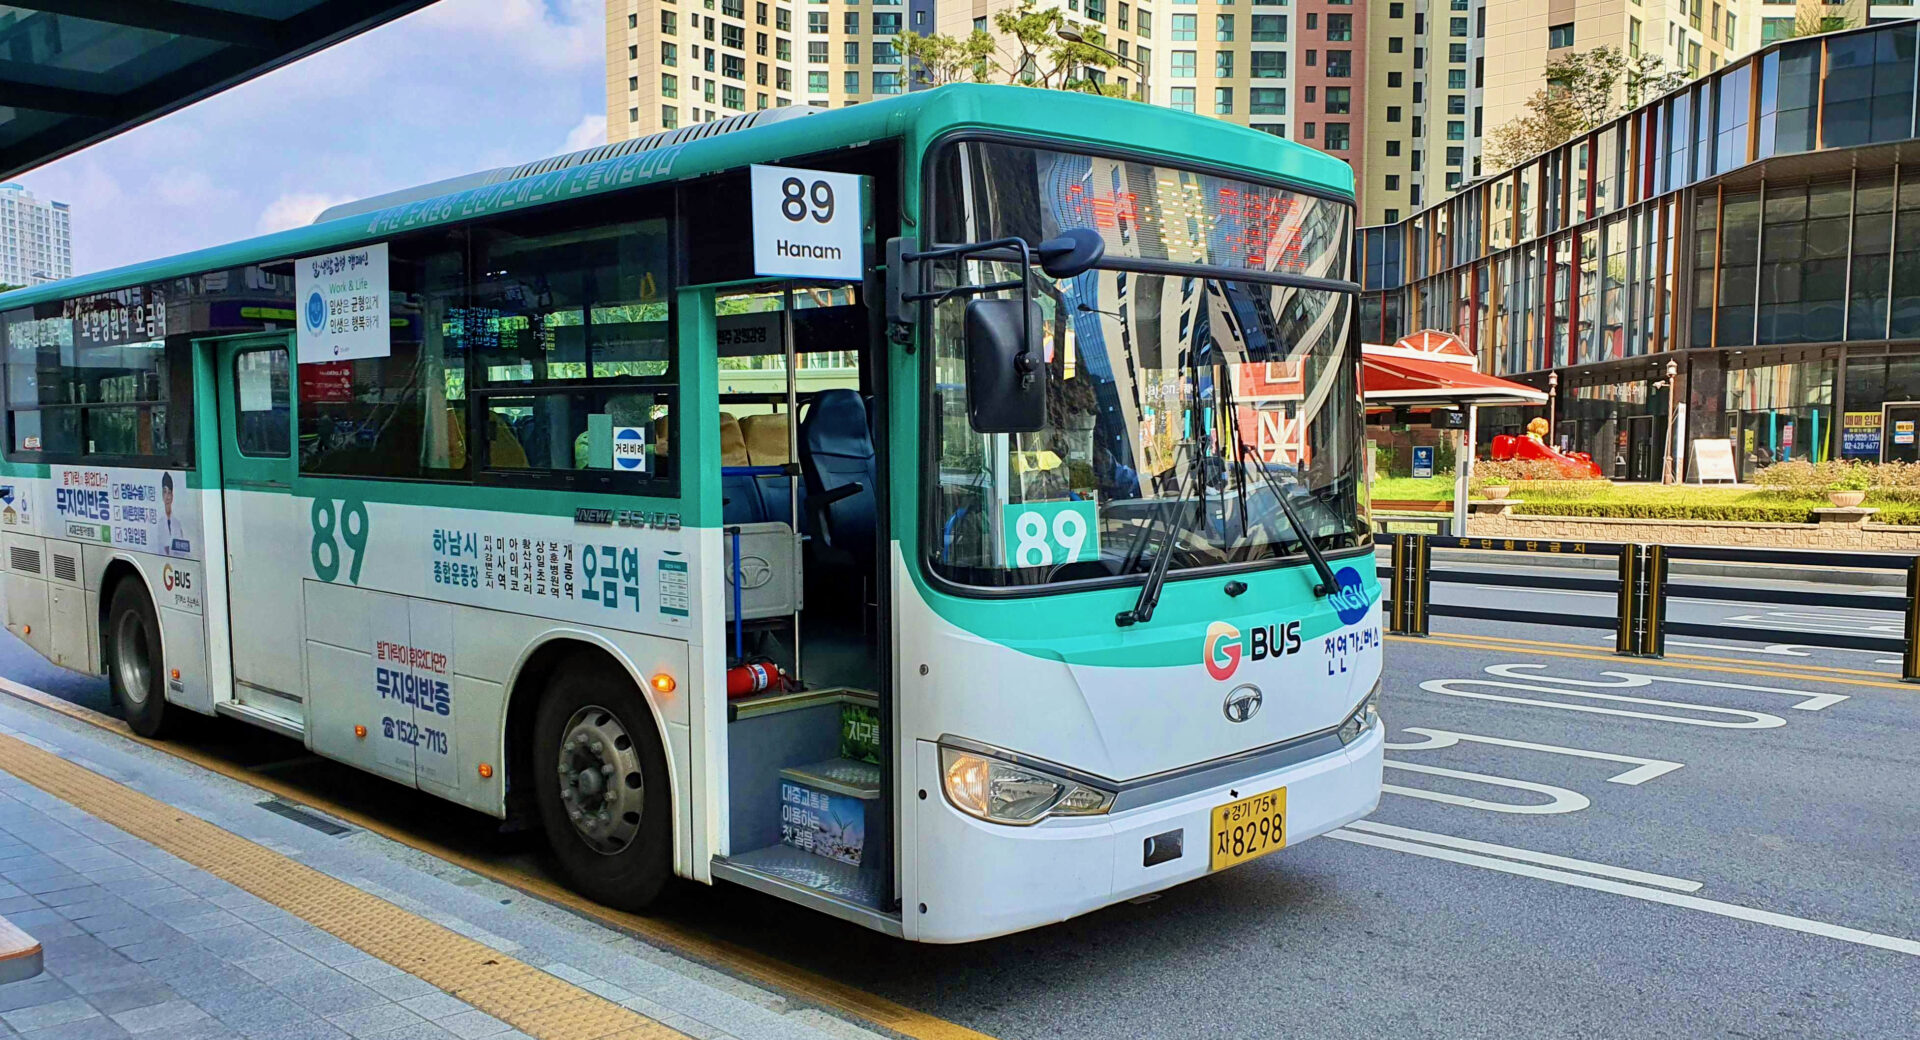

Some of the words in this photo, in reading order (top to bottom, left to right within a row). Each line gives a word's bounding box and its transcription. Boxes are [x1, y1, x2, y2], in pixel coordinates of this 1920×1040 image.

[781, 176, 835, 224] 89
[776, 239, 842, 260] Hanam
[329, 281, 346, 294] Work
[348, 281, 354, 291] &
[355, 280, 368, 290] Life
[330, 298, 350, 315] 일상은
[351, 295, 379, 312] 균형있게
[82, 307, 130, 342] 보훈병원역
[135, 302, 167, 337] 오금역
[330, 318, 350, 334] 인생은
[352, 315, 380, 332] 행복하게
[1845, 415, 1863, 426] 매매
[1864, 414, 1882, 426] 임대
[615, 443, 644, 455] 거리비례
[56, 488, 110, 521] 무지외반증
[123, 527, 147, 545] 3일입원
[311, 496, 369, 585] 89
[433, 529, 478, 559] 하남시
[1016, 509, 1087, 568] 89
[1458, 538, 1586, 554] 무단횡단금지
[163, 563, 174, 591] G
[174, 570, 191, 589] BUS
[433, 561, 479, 589] 종합운동장
[484, 535, 494, 589] 미사강변도시
[496, 537, 506, 590] 미사역
[509, 538, 519, 591] 아이테코
[522, 538, 532, 594] 황산사거리
[535, 540, 546, 595] 상일초교
[549, 542, 559, 599] 보훈병원역
[563, 544, 574, 600] 개롱역
[582, 544, 640, 612] 오금역
[1327, 583, 1369, 611] NGV
[377, 641, 409, 665] 발가락이
[409, 648, 447, 674] 휘었다면?
[1204, 620, 1242, 682] G
[1250, 620, 1301, 662] BUS
[376, 667, 450, 716] 무지외반증
[395, 719, 448, 755] 1522-7113
[782, 783, 829, 811] 대중교통을
[1231, 801, 1251, 821] 경기
[1253, 796, 1270, 815] 75
[782, 804, 820, 830] 이용하는
